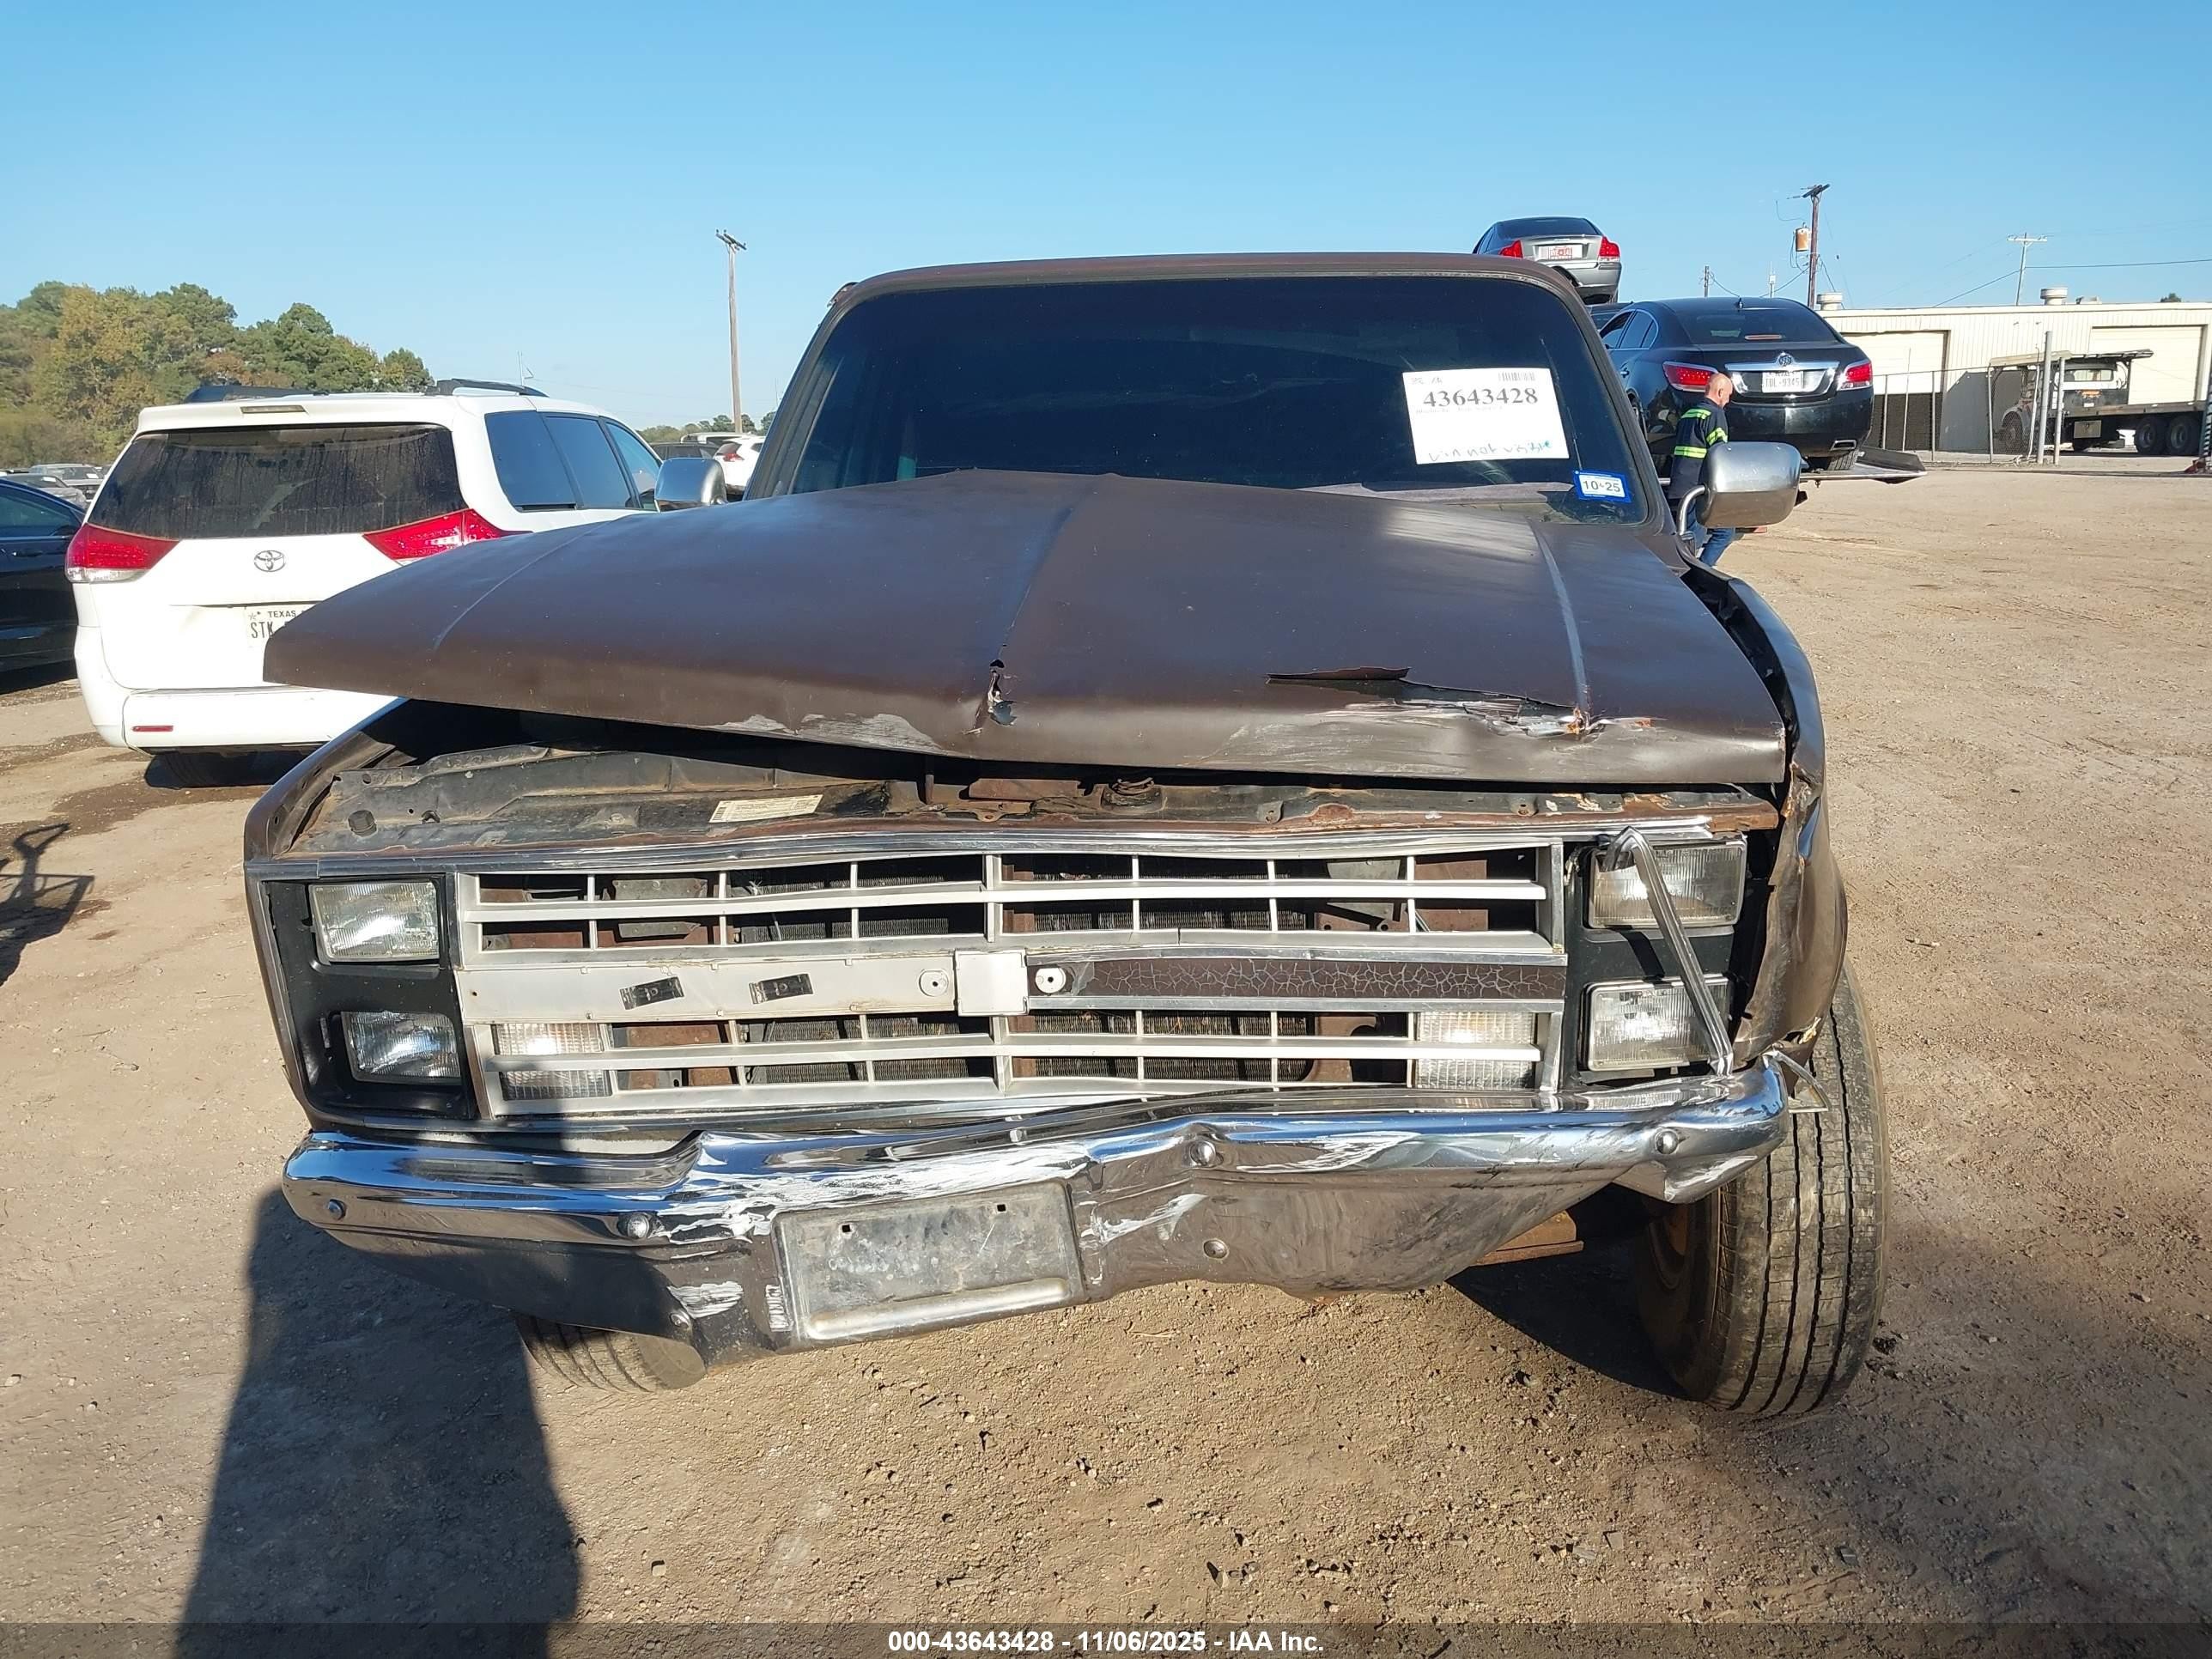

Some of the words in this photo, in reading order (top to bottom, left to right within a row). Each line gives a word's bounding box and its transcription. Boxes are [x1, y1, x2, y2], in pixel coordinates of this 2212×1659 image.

[1424, 387, 1538, 407] 43643428
[1467, 442, 1498, 458] not
[1504, 440, 1553, 455] visible
[251, 622, 274, 638] STK
